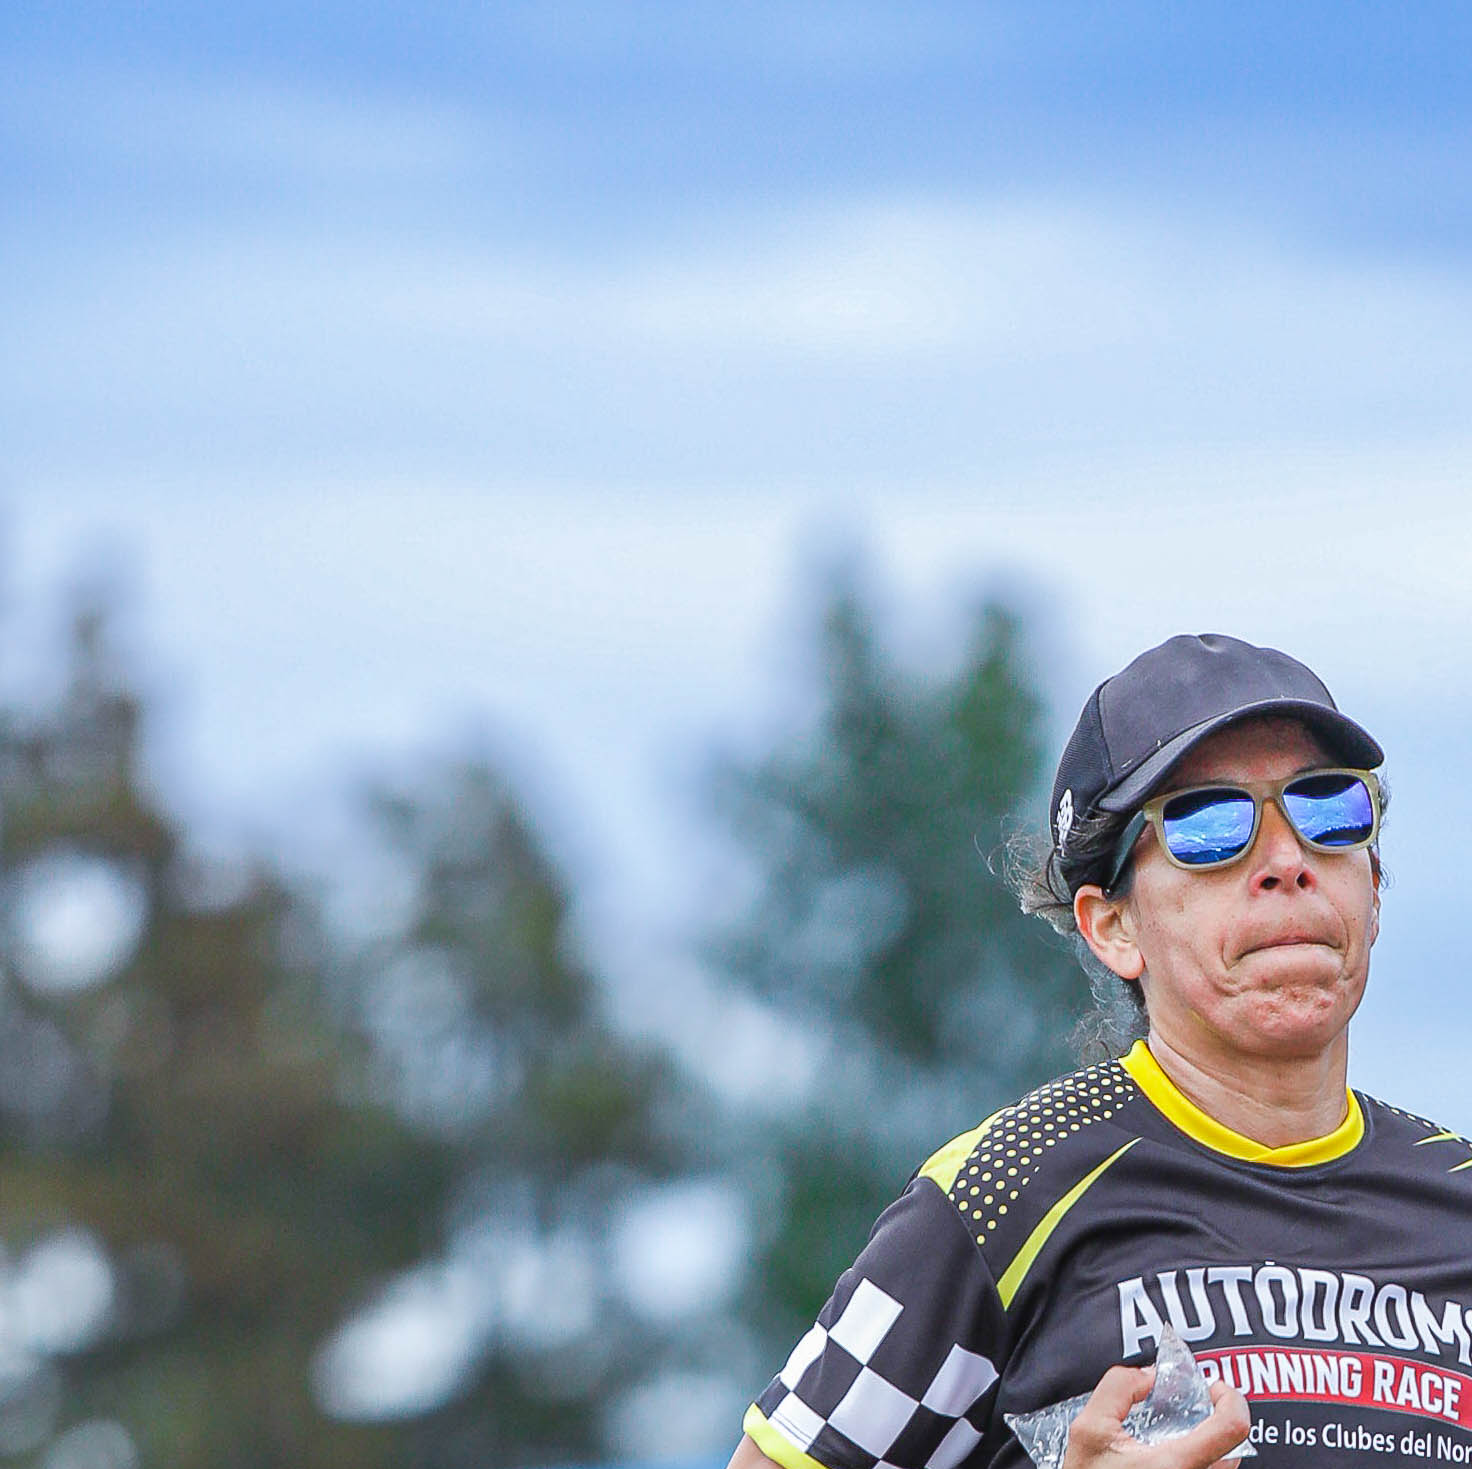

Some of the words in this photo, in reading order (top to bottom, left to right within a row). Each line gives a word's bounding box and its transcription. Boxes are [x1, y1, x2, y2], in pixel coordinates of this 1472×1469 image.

[1373, 1358, 1462, 1421] RACE
[1249, 1418, 1279, 1444] de
[1285, 1420, 1317, 1446] los
[1322, 1423, 1395, 1452] Clubes
[1400, 1430, 1432, 1458] del
